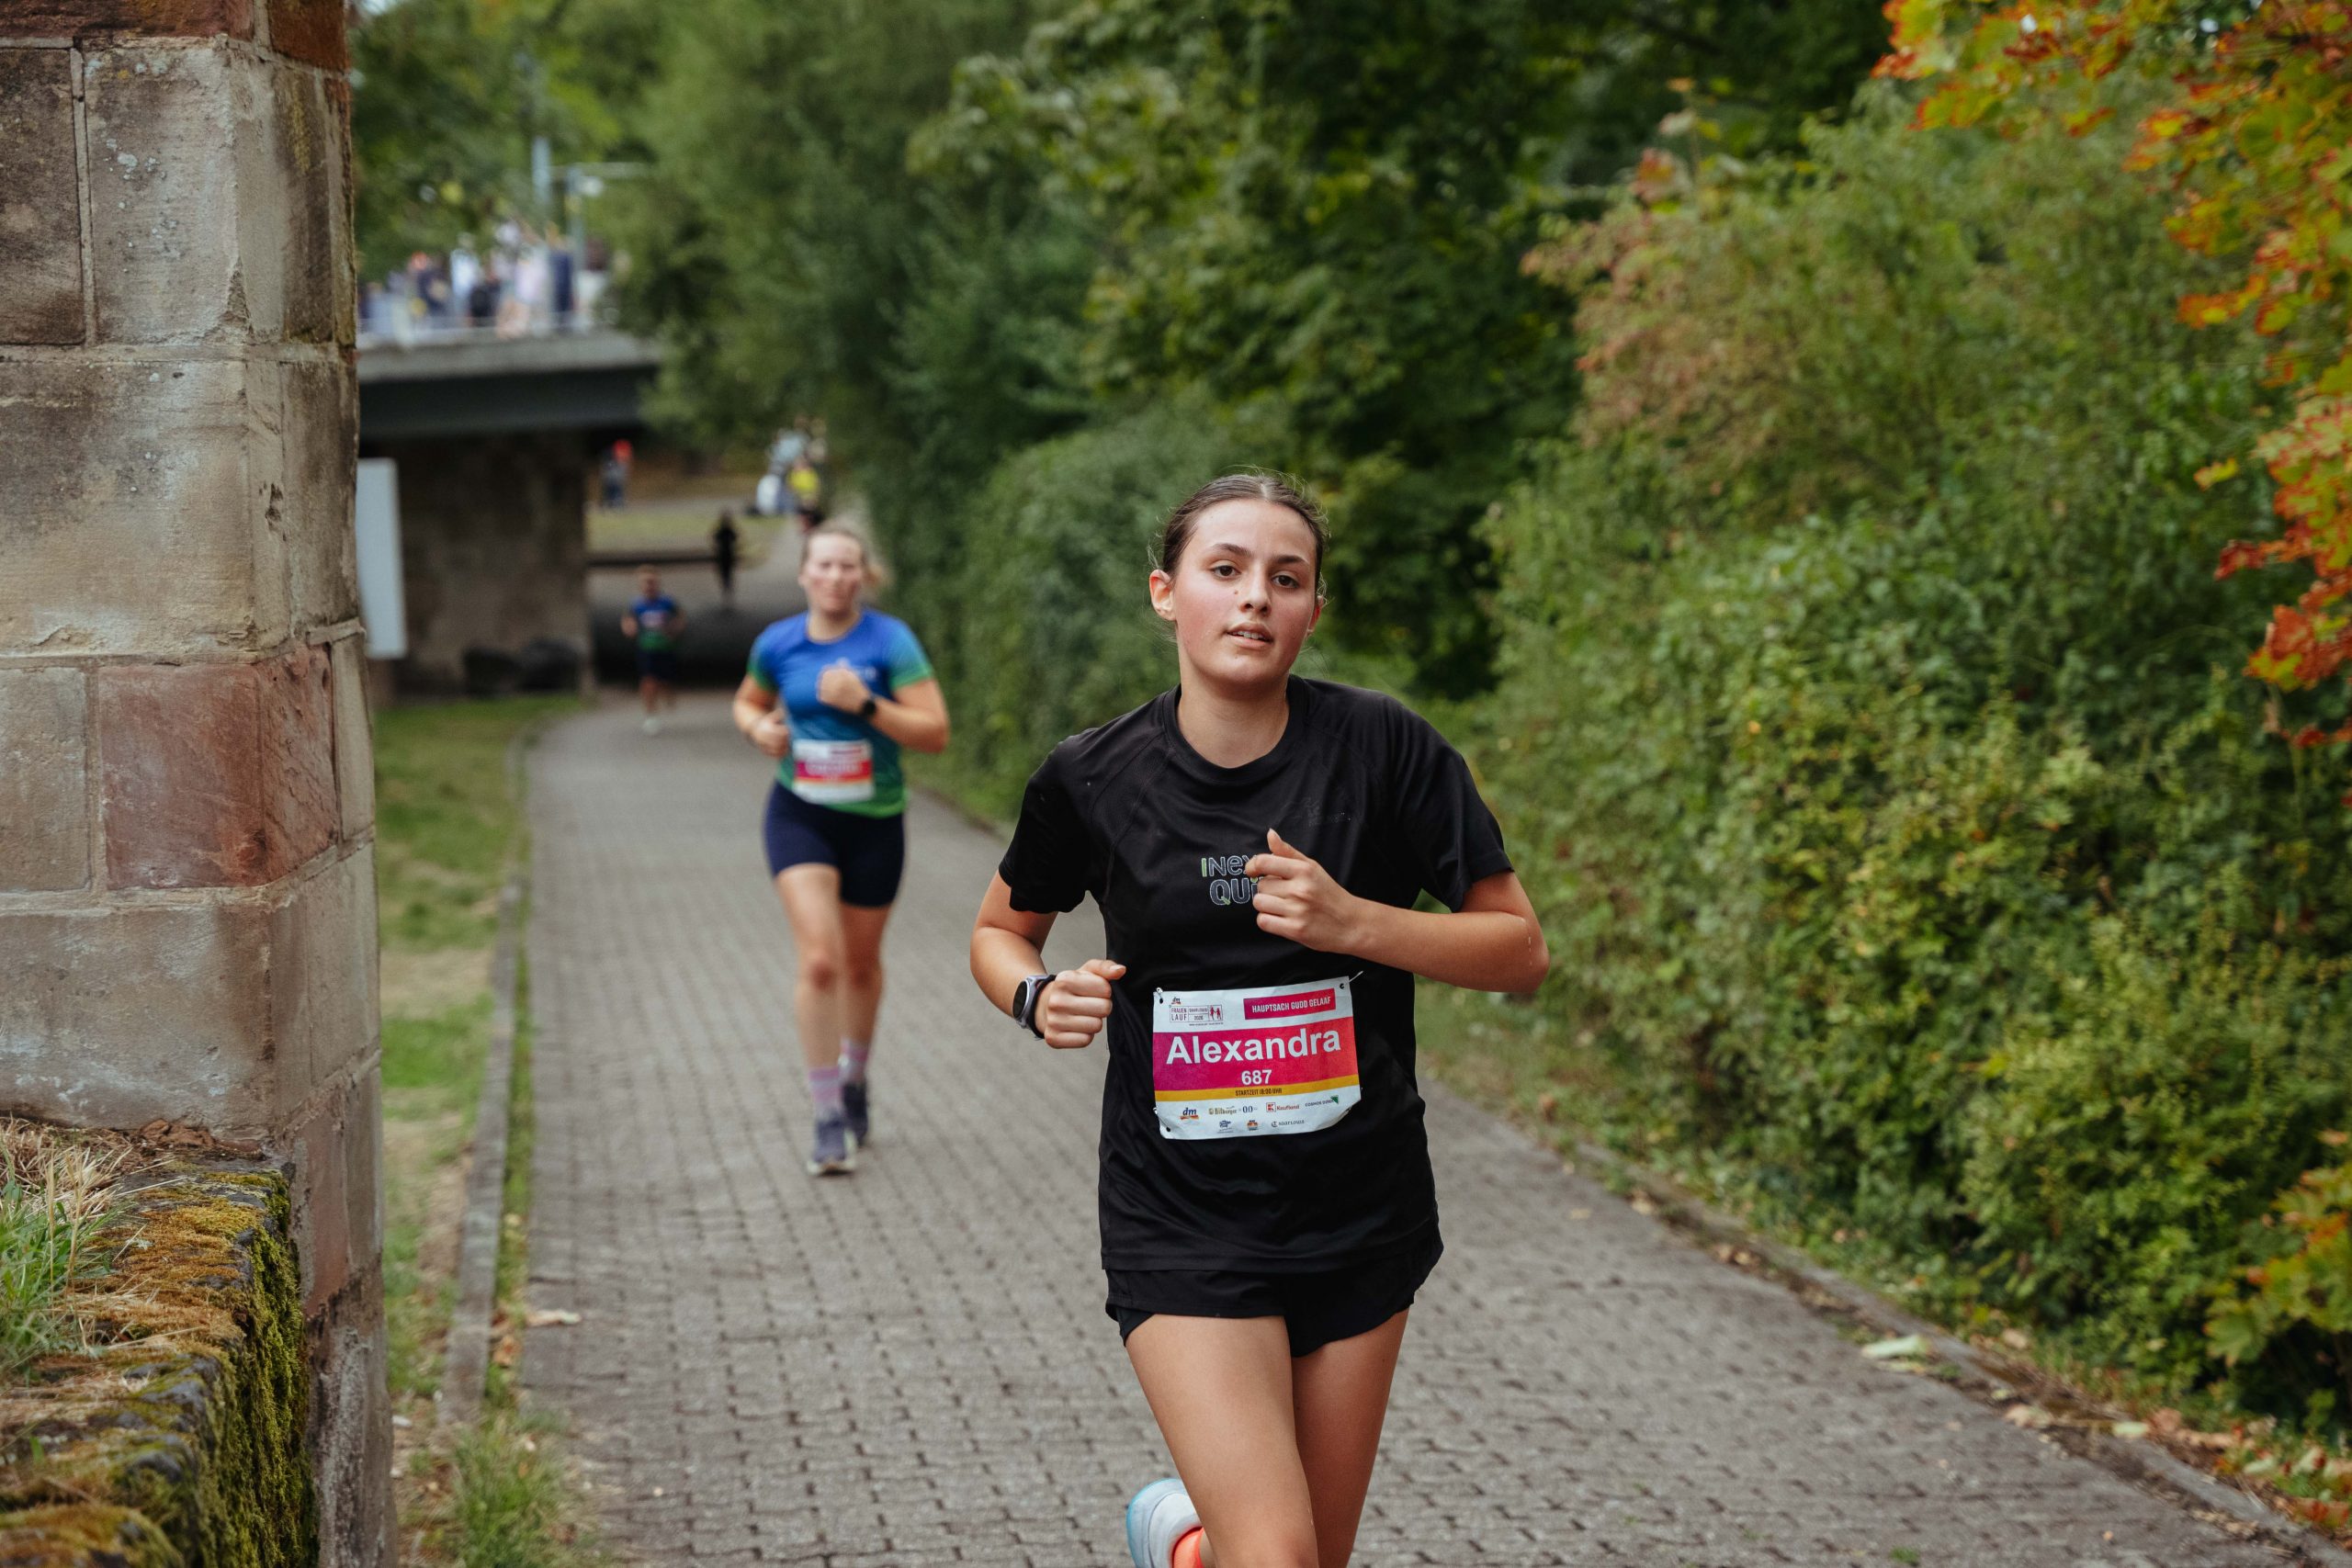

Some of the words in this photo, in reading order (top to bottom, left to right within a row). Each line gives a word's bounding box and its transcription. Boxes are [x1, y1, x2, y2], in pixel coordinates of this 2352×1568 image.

[1209, 877, 1259, 906] QUi
[1251, 1003, 1290, 1013] HAUPTSACH
[1291, 999, 1308, 1010] GUDD
[1308, 996, 1331, 1008] GELAAF
[1170, 1013, 1187, 1021] LAUF
[1166, 1028, 1341, 1065] Alexandra
[1241, 1069, 1272, 1086] 687
[1235, 1089, 1259, 1097] STARTZEIT
[1182, 1107, 1197, 1116] dm
